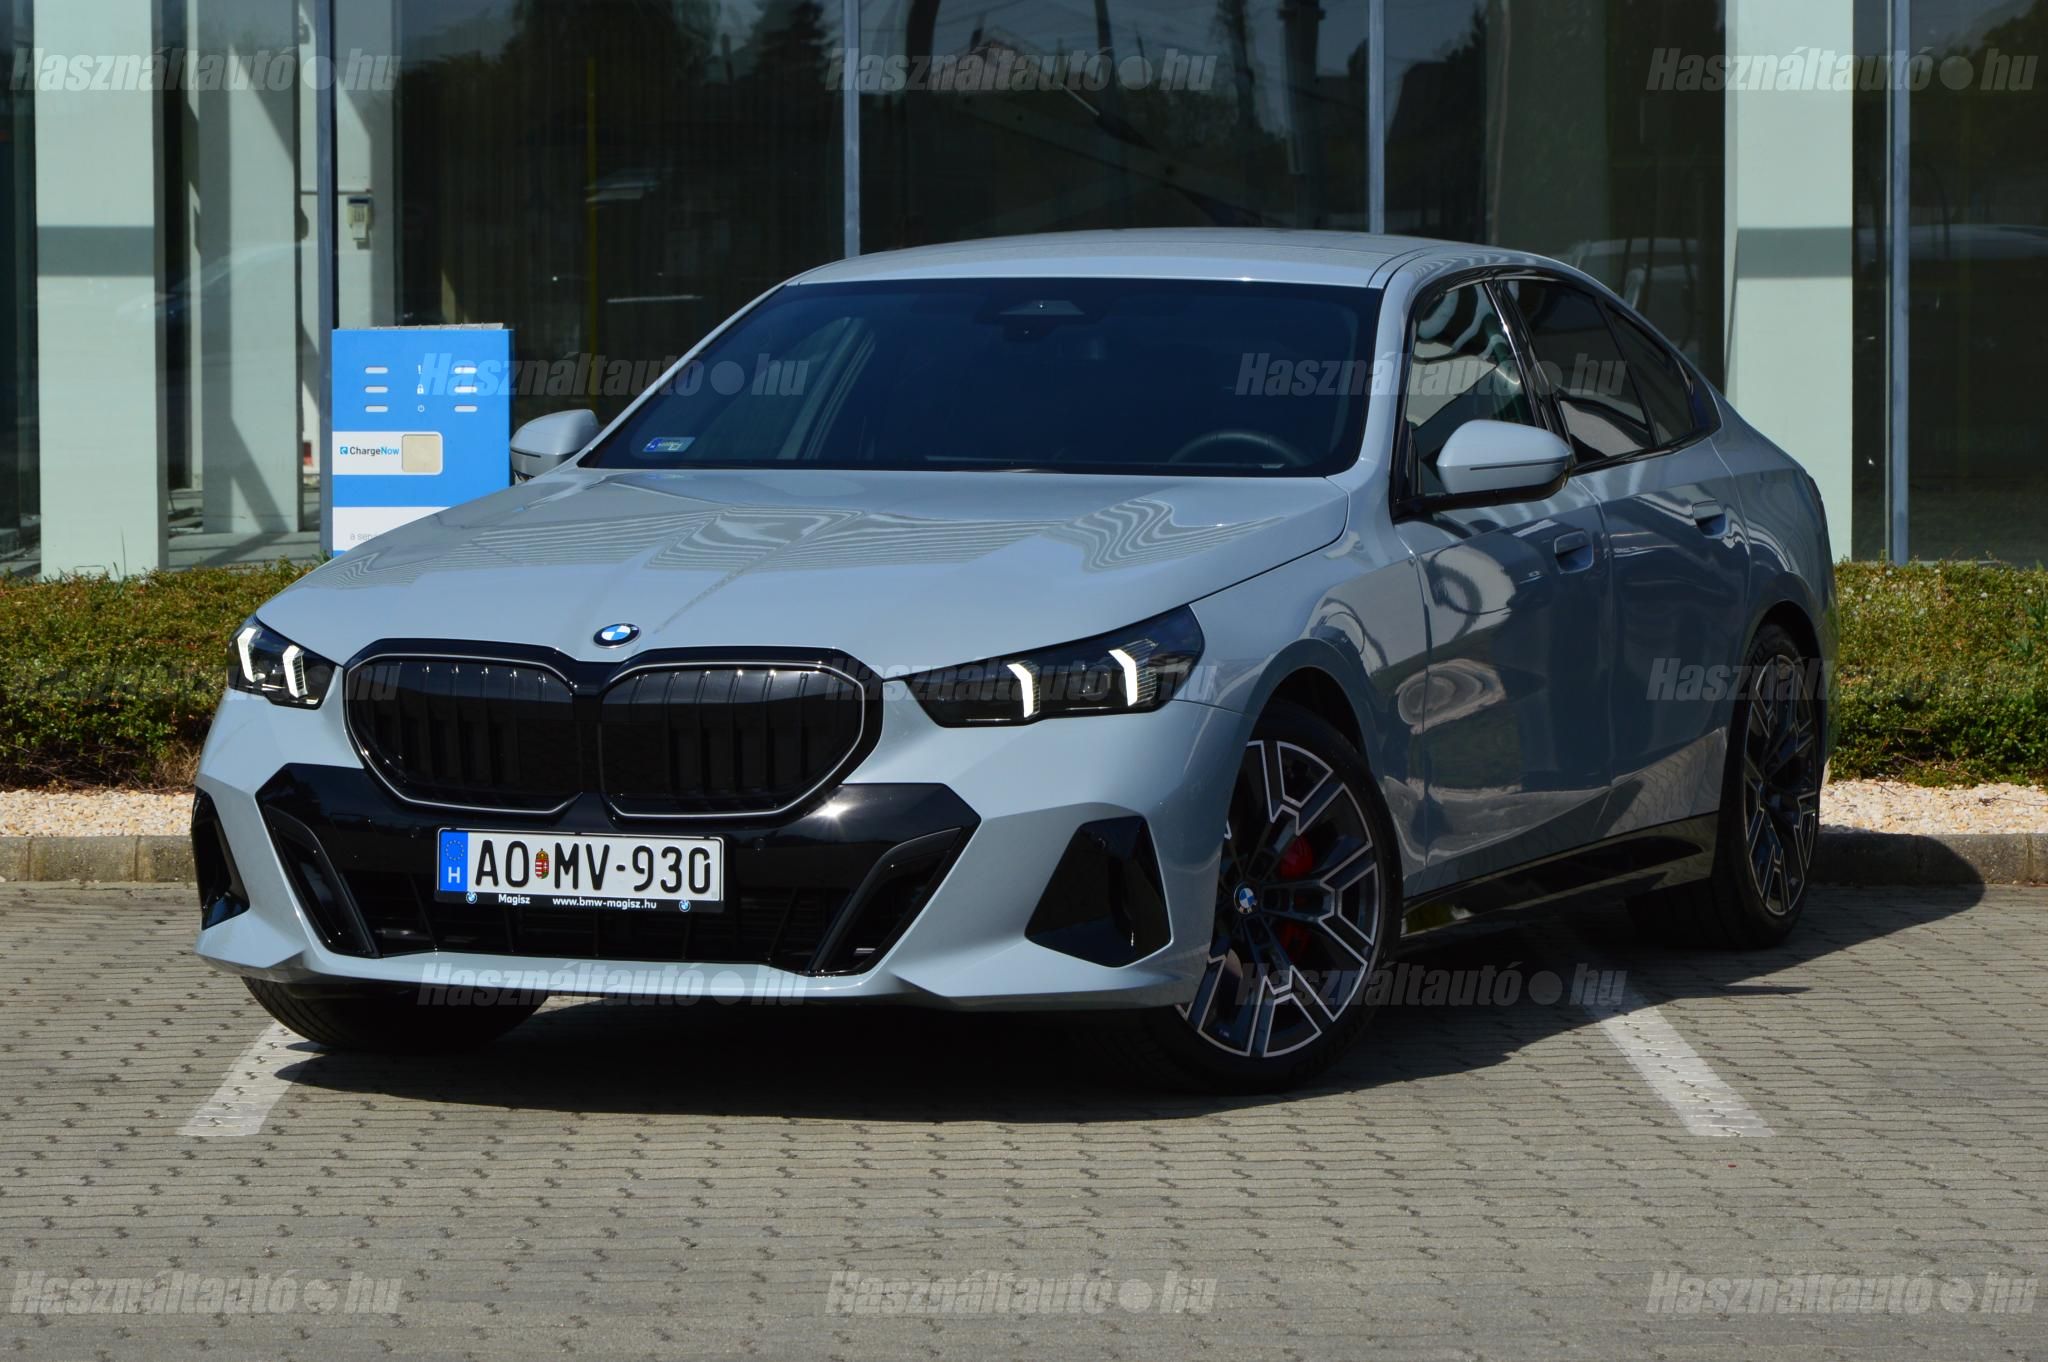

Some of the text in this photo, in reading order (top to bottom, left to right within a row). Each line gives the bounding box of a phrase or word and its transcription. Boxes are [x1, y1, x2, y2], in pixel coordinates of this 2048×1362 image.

[350, 446, 400, 457] ChargeNow
[448, 866, 461, 884] H
[554, 842, 711, 895] MV-930
[498, 893, 657, 910] Magisz www.bmw-magisz.hu
